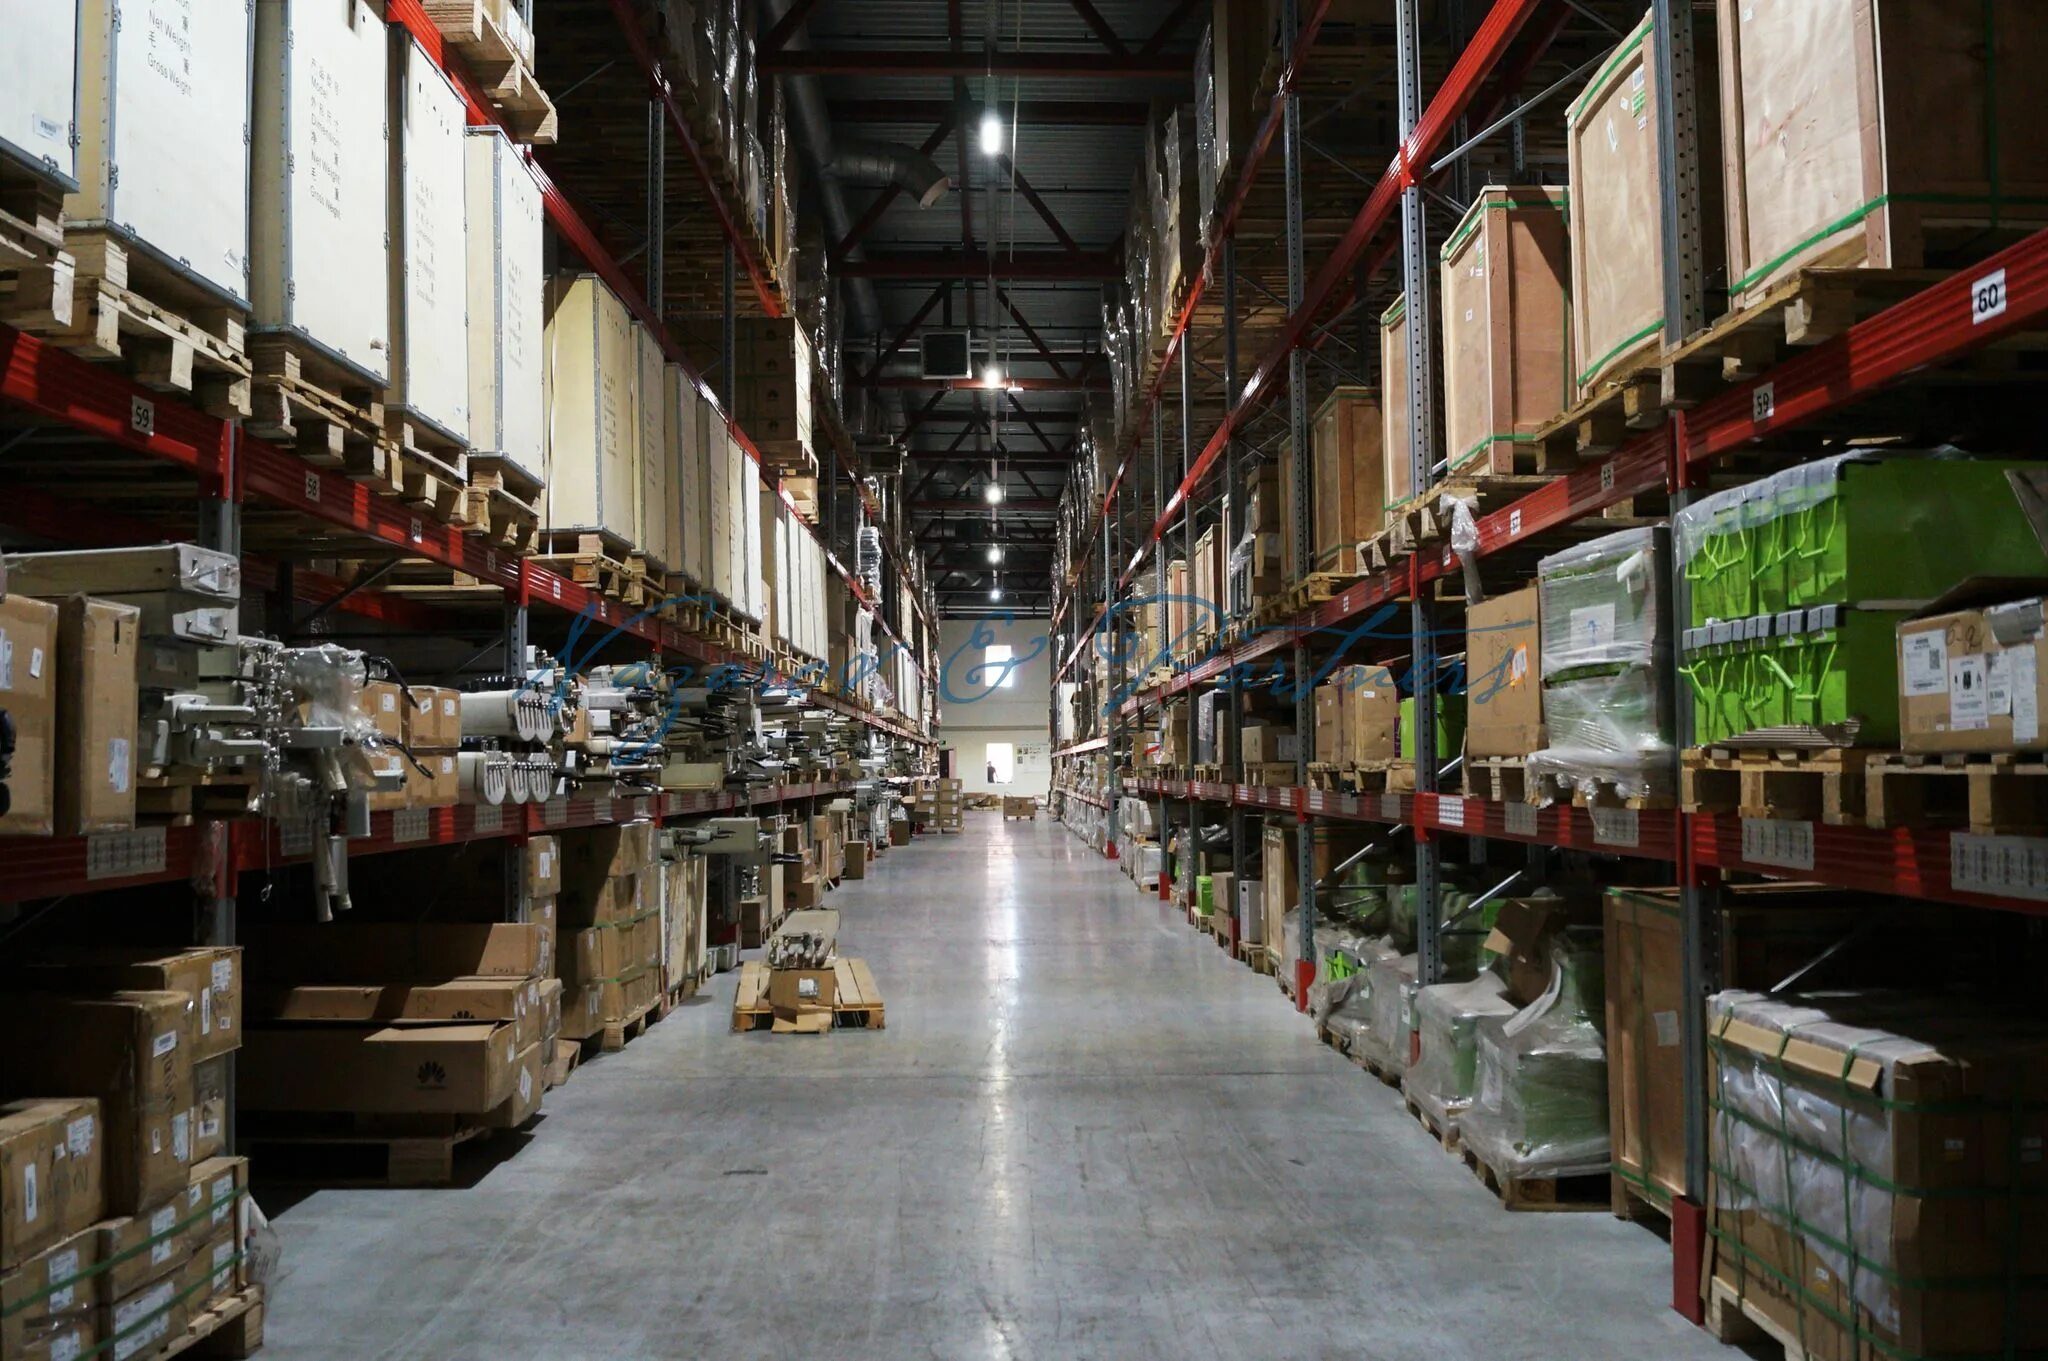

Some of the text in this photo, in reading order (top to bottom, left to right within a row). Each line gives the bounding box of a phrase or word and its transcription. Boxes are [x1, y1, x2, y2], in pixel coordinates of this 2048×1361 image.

[149, 9, 191, 54] Net Weight
[148, 52, 168, 79] Gross
[1979, 284, 1998, 313] 60
[136, 405, 149, 427] 59
[1757, 393, 1769, 416] 59
